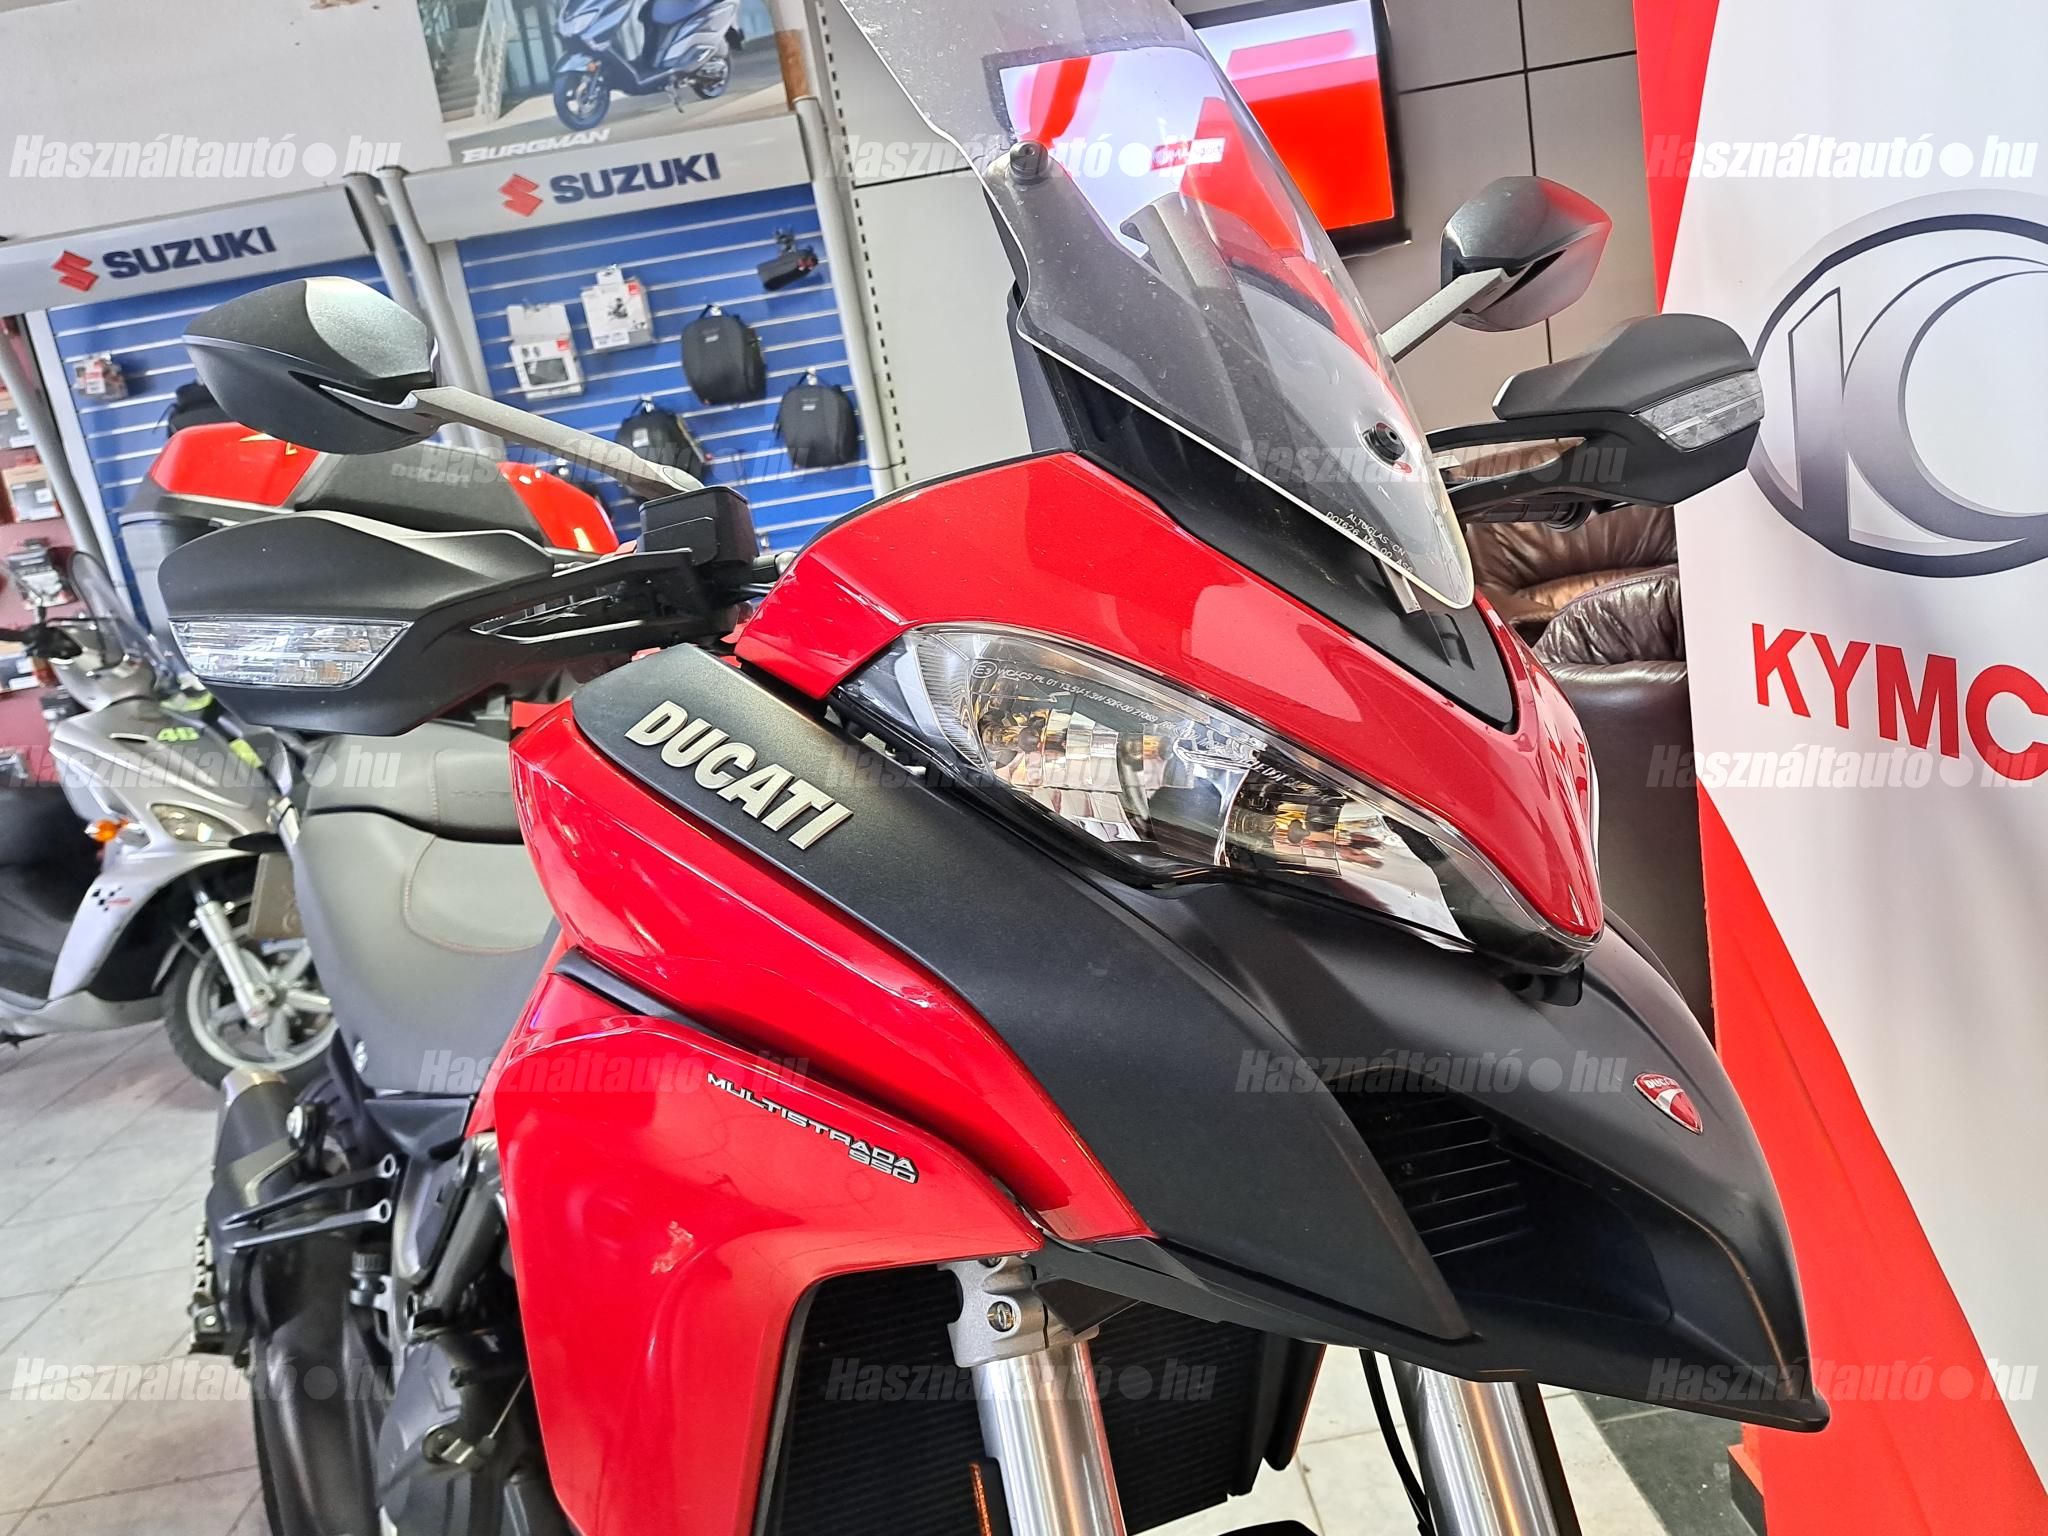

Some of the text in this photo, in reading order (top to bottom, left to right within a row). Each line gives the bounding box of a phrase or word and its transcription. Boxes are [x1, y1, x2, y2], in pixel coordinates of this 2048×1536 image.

[461, 128, 611, 163] BURGMAN
[550, 152, 720, 204] SUZUKI
[102, 227, 275, 280] SUZUKI
[623, 700, 854, 850] DUCATI
[707, 1072, 918, 1175] MULTISTRADA
[848, 1148, 918, 1184] 950
